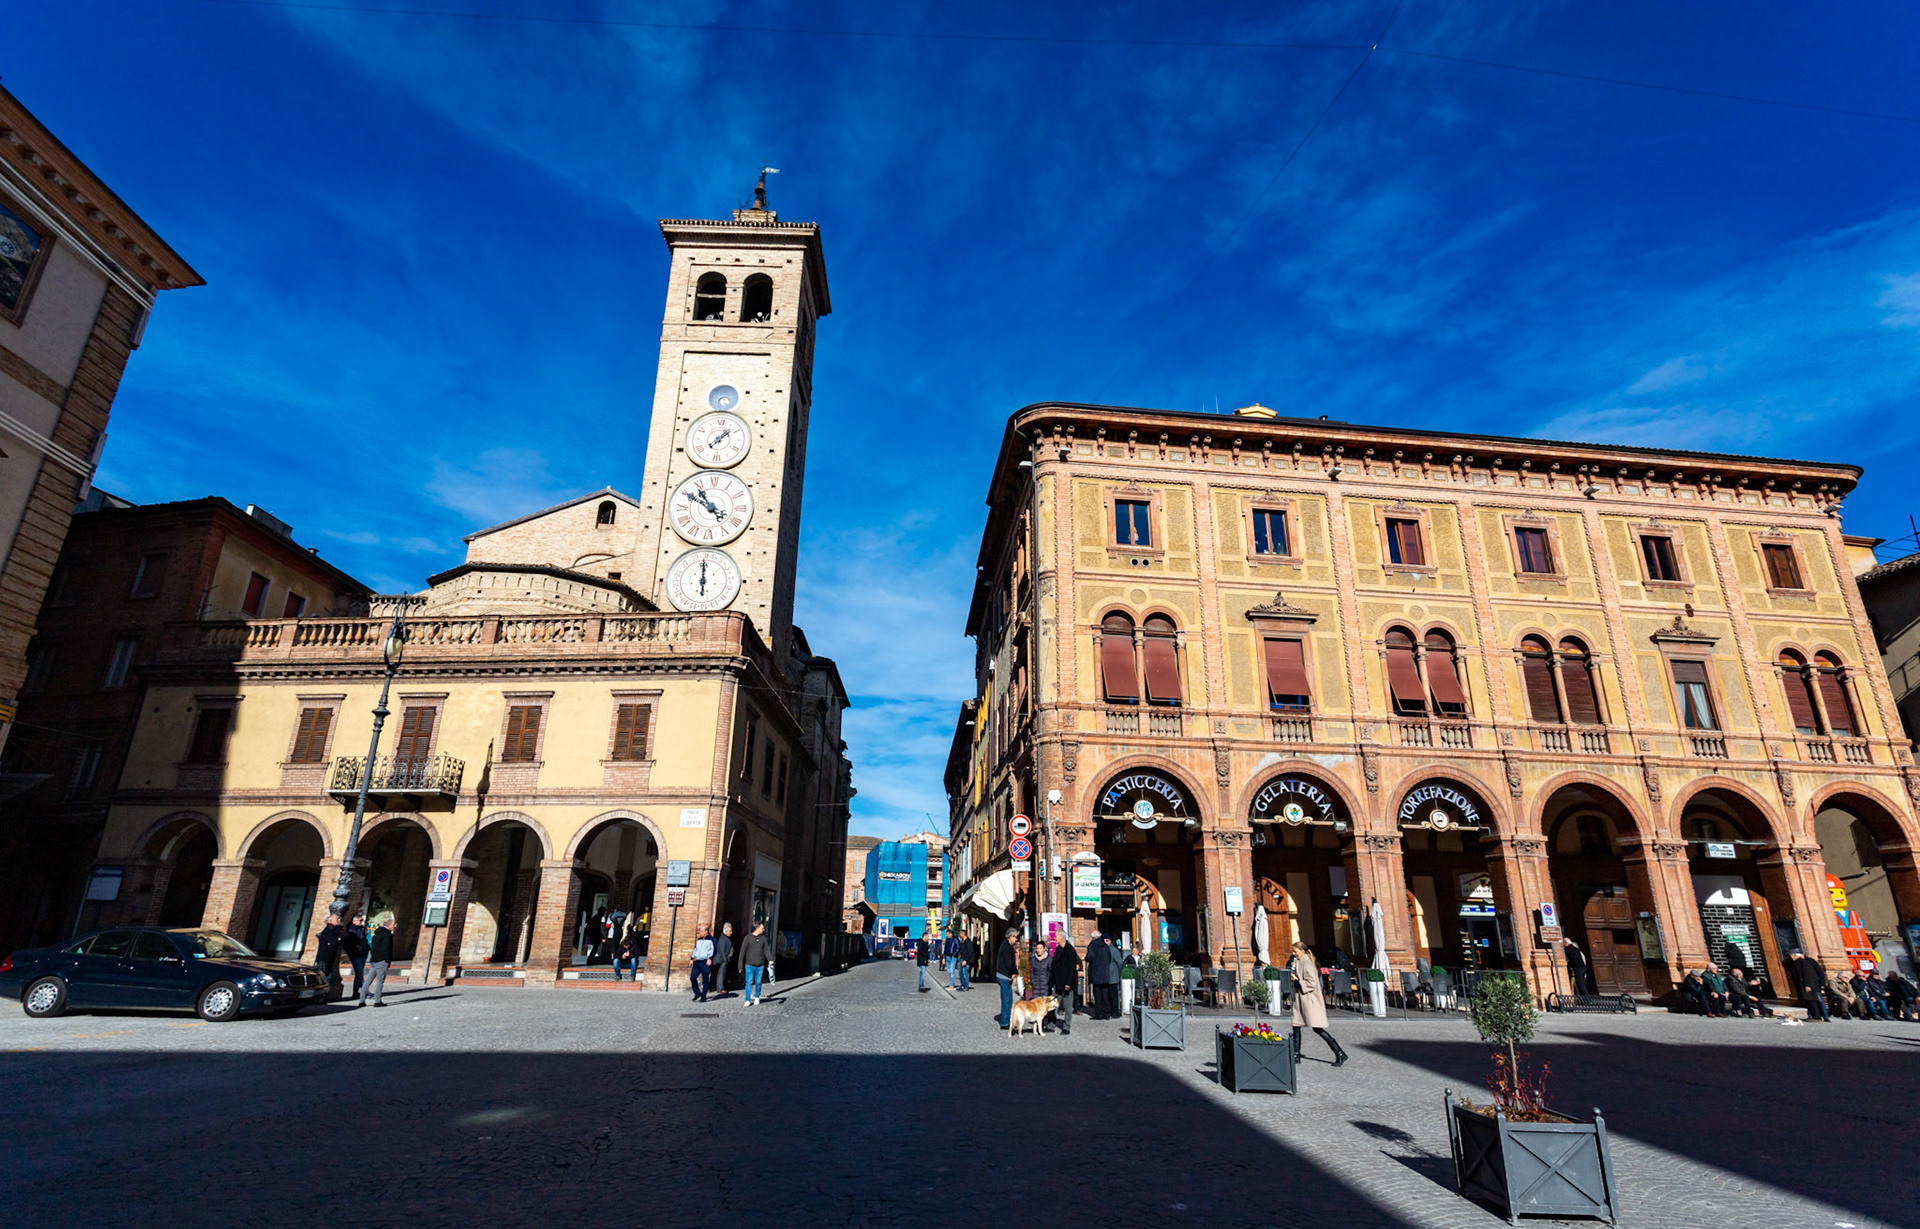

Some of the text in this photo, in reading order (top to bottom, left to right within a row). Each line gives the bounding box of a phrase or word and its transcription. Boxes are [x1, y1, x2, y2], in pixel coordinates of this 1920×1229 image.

[1102, 775, 1183, 810] PASTICCERIA
[1136, 801, 1153, 817] BAR
[1255, 779, 1332, 815] GELATERIA
[1400, 785, 1480, 823] TORREFAZIONE
